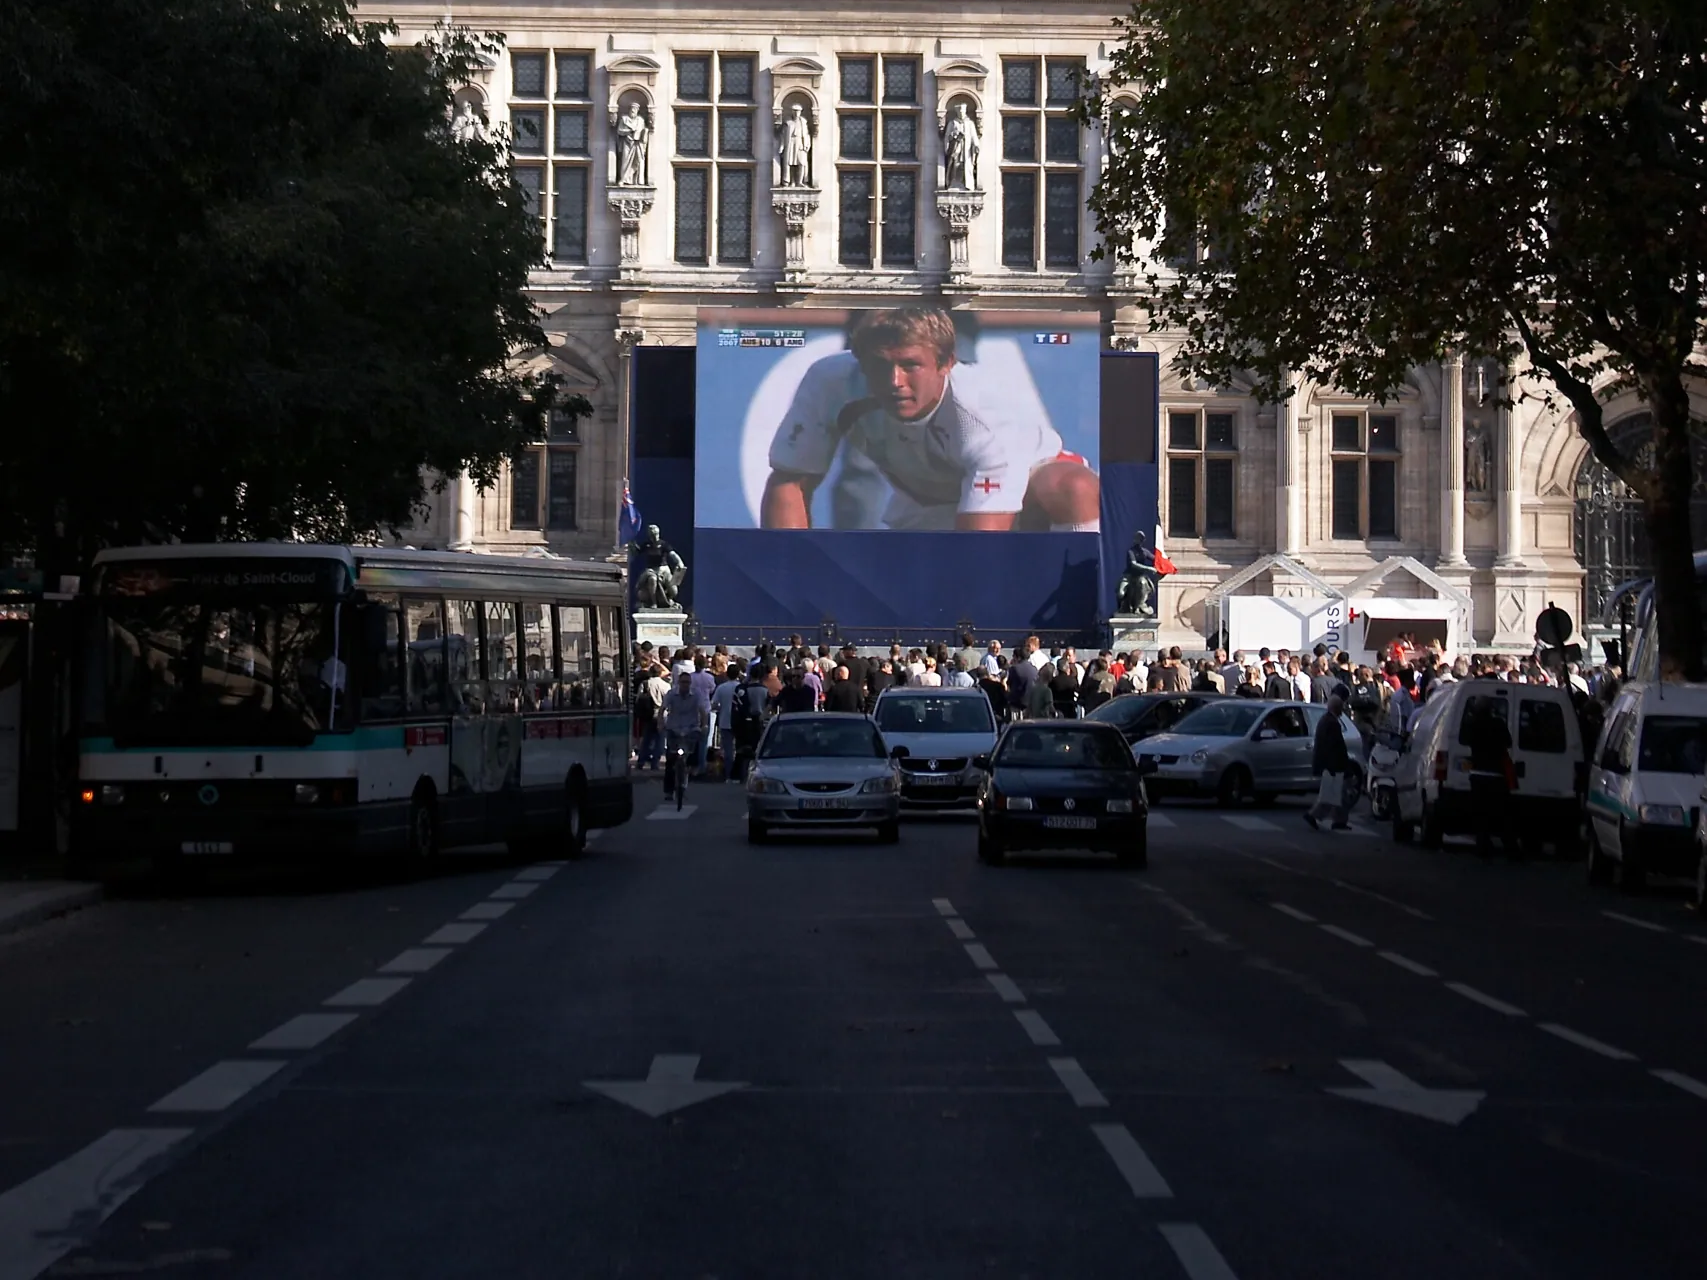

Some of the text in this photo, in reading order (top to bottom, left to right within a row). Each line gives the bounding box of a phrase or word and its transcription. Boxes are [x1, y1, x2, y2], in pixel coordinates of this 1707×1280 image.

[1035, 333, 1067, 343] TF1
[223, 571, 240, 585] de
[243, 570, 317, 585] Saint-Cloud
[1327, 607, 1340, 655] OURS
